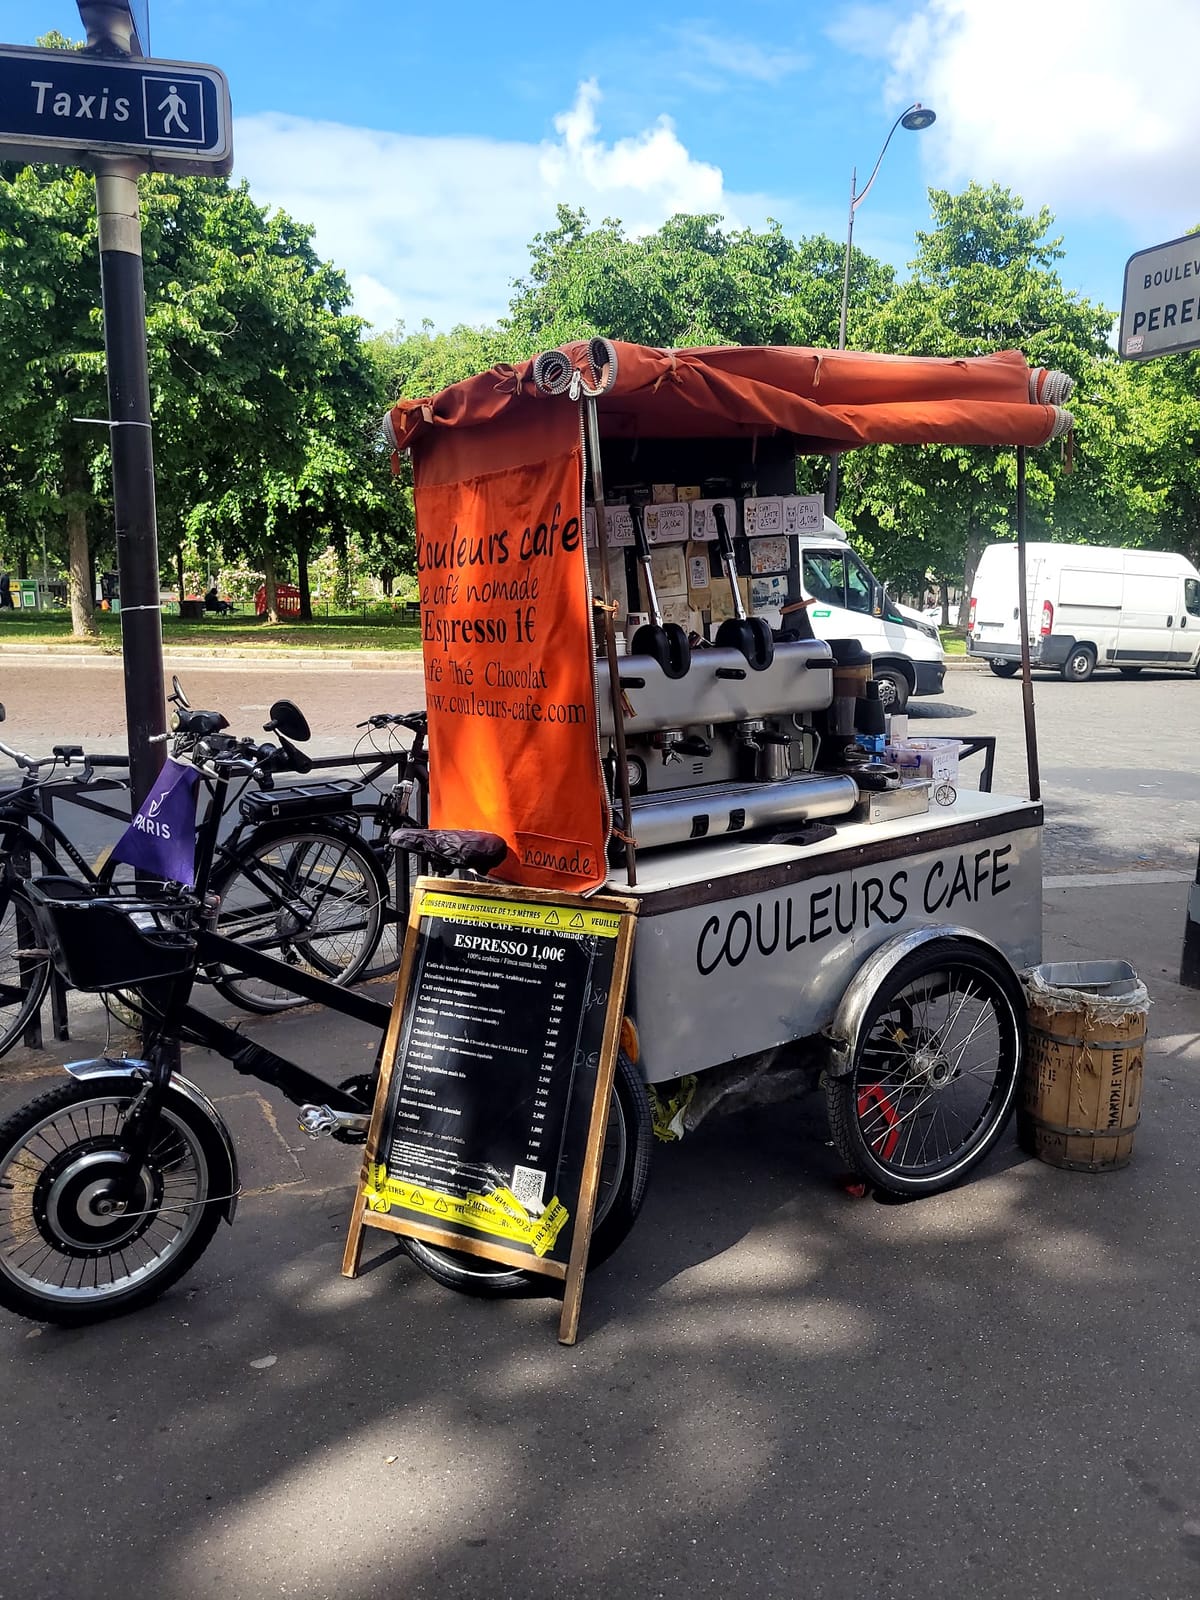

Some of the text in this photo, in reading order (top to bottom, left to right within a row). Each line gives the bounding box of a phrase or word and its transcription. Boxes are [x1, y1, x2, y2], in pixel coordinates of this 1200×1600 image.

[30, 80, 131, 122] Taxis
[417, 502, 580, 572] Couleurs cafe
[467, 567, 540, 602] nomade
[424, 606, 537, 652] Espresso 1€
[485, 661, 549, 689] Chocolat
[133, 813, 171, 839] PARIS
[525, 848, 592, 875] nomade
[457, 903, 470, 911] UNE
[470, 904, 498, 914] DISTANCE
[497, 907, 506, 915] DE
[696, 844, 1012, 976] COULEURS CAFE
[453, 933, 566, 962] ESPRESSO 1,00€
[552, 930, 584, 941] Nomade
[1111, 1048, 1124, 1076] WIT
